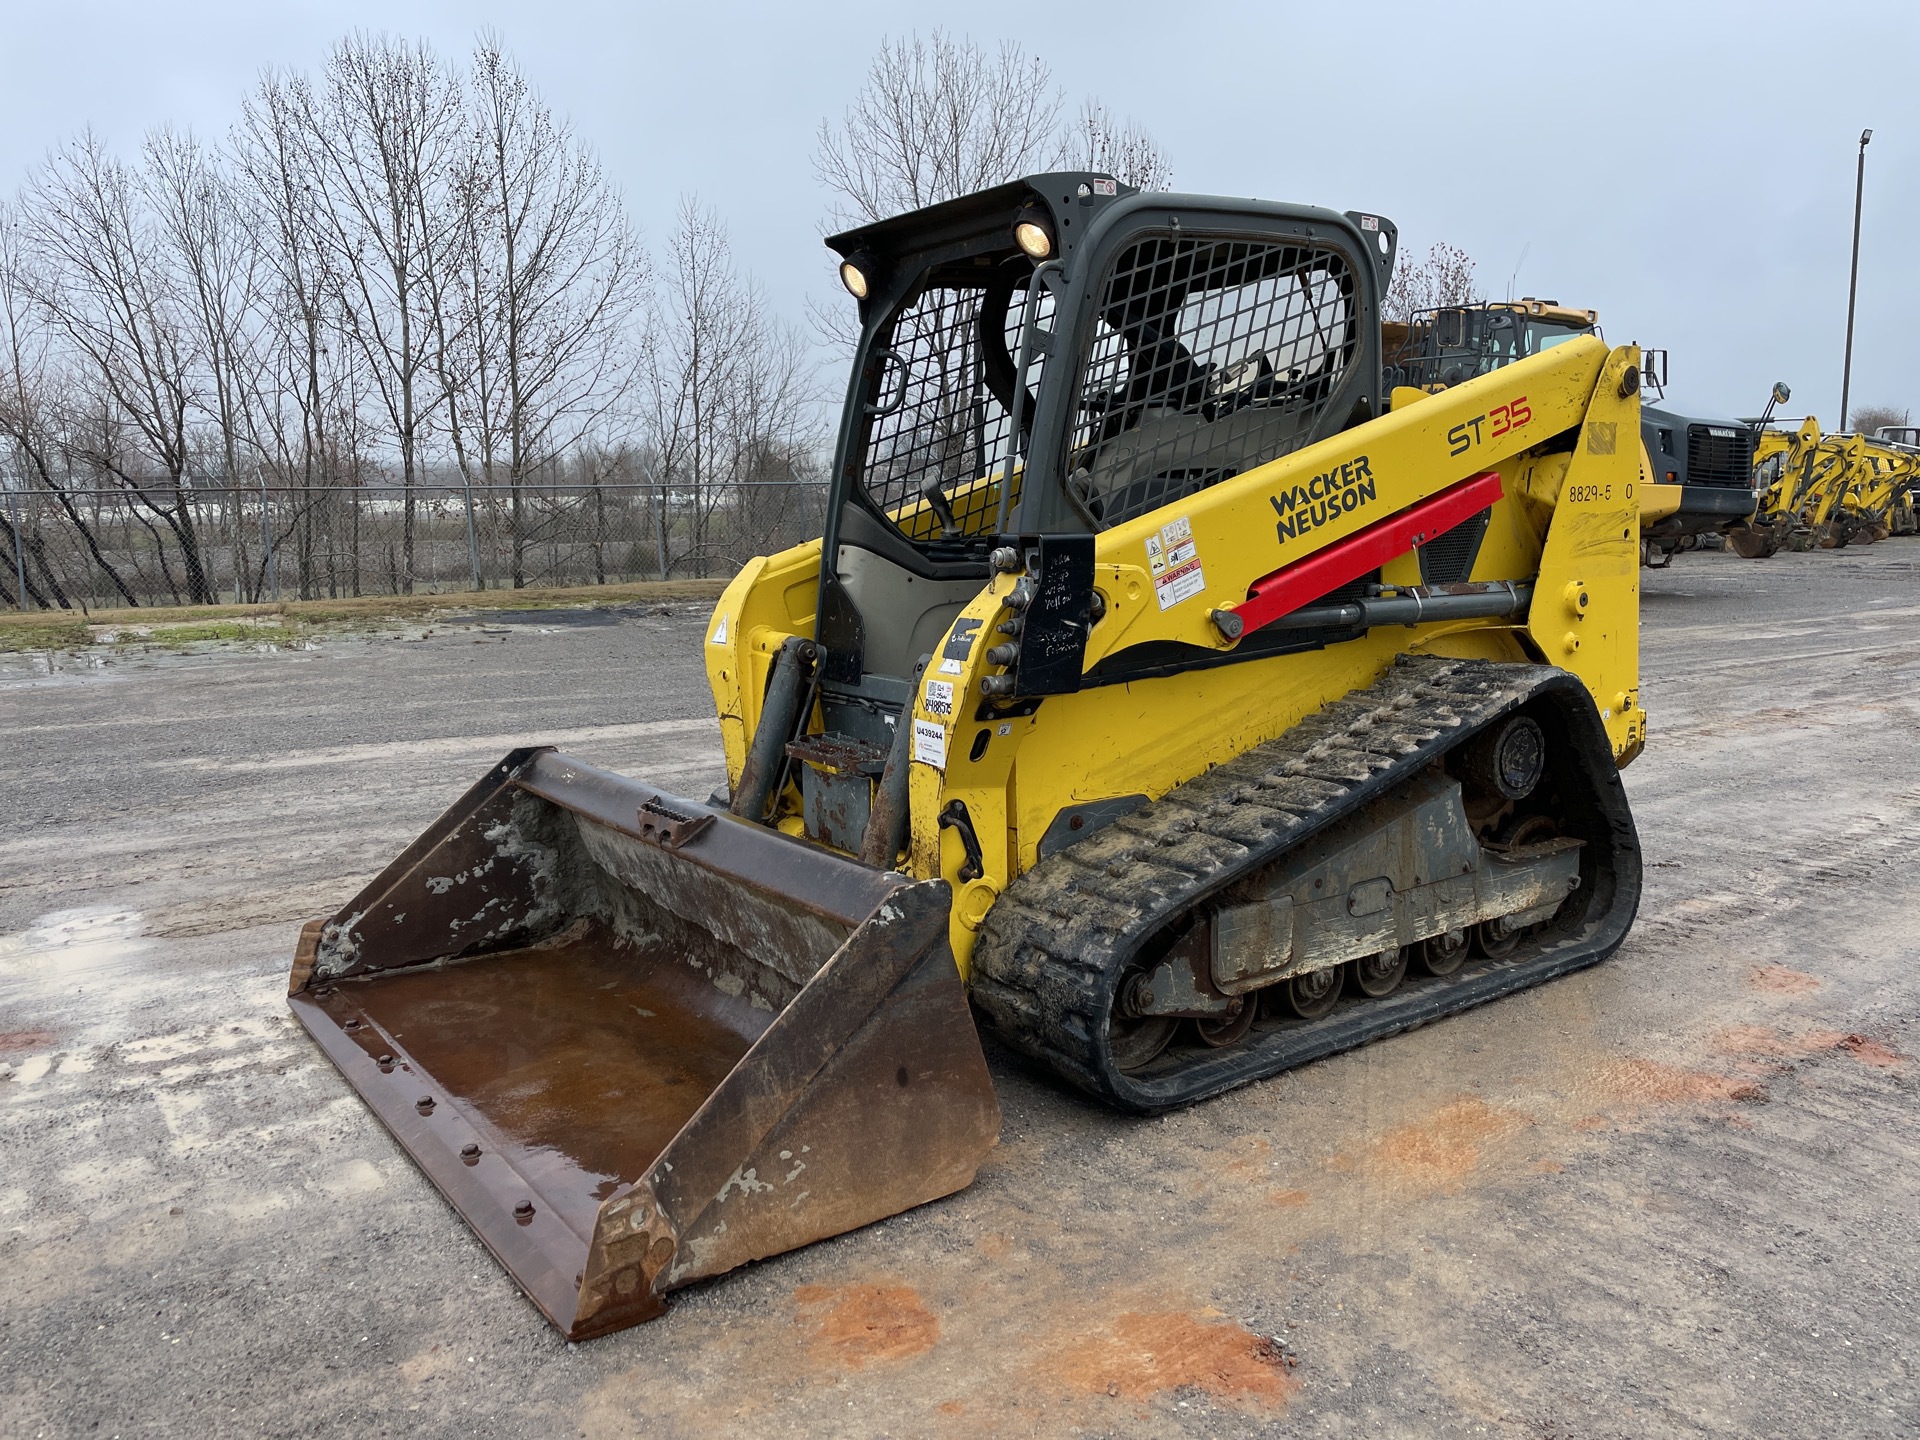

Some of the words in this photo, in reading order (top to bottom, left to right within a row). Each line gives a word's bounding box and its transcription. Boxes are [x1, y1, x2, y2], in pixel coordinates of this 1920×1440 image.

[1709, 429, 1736, 438] KOMATSU
[1269, 455, 1373, 517] WACKER
[1276, 477, 1377, 545] NEUSON
[1167, 562, 1195, 582] WARNING
[916, 726, 943, 741] U439244
